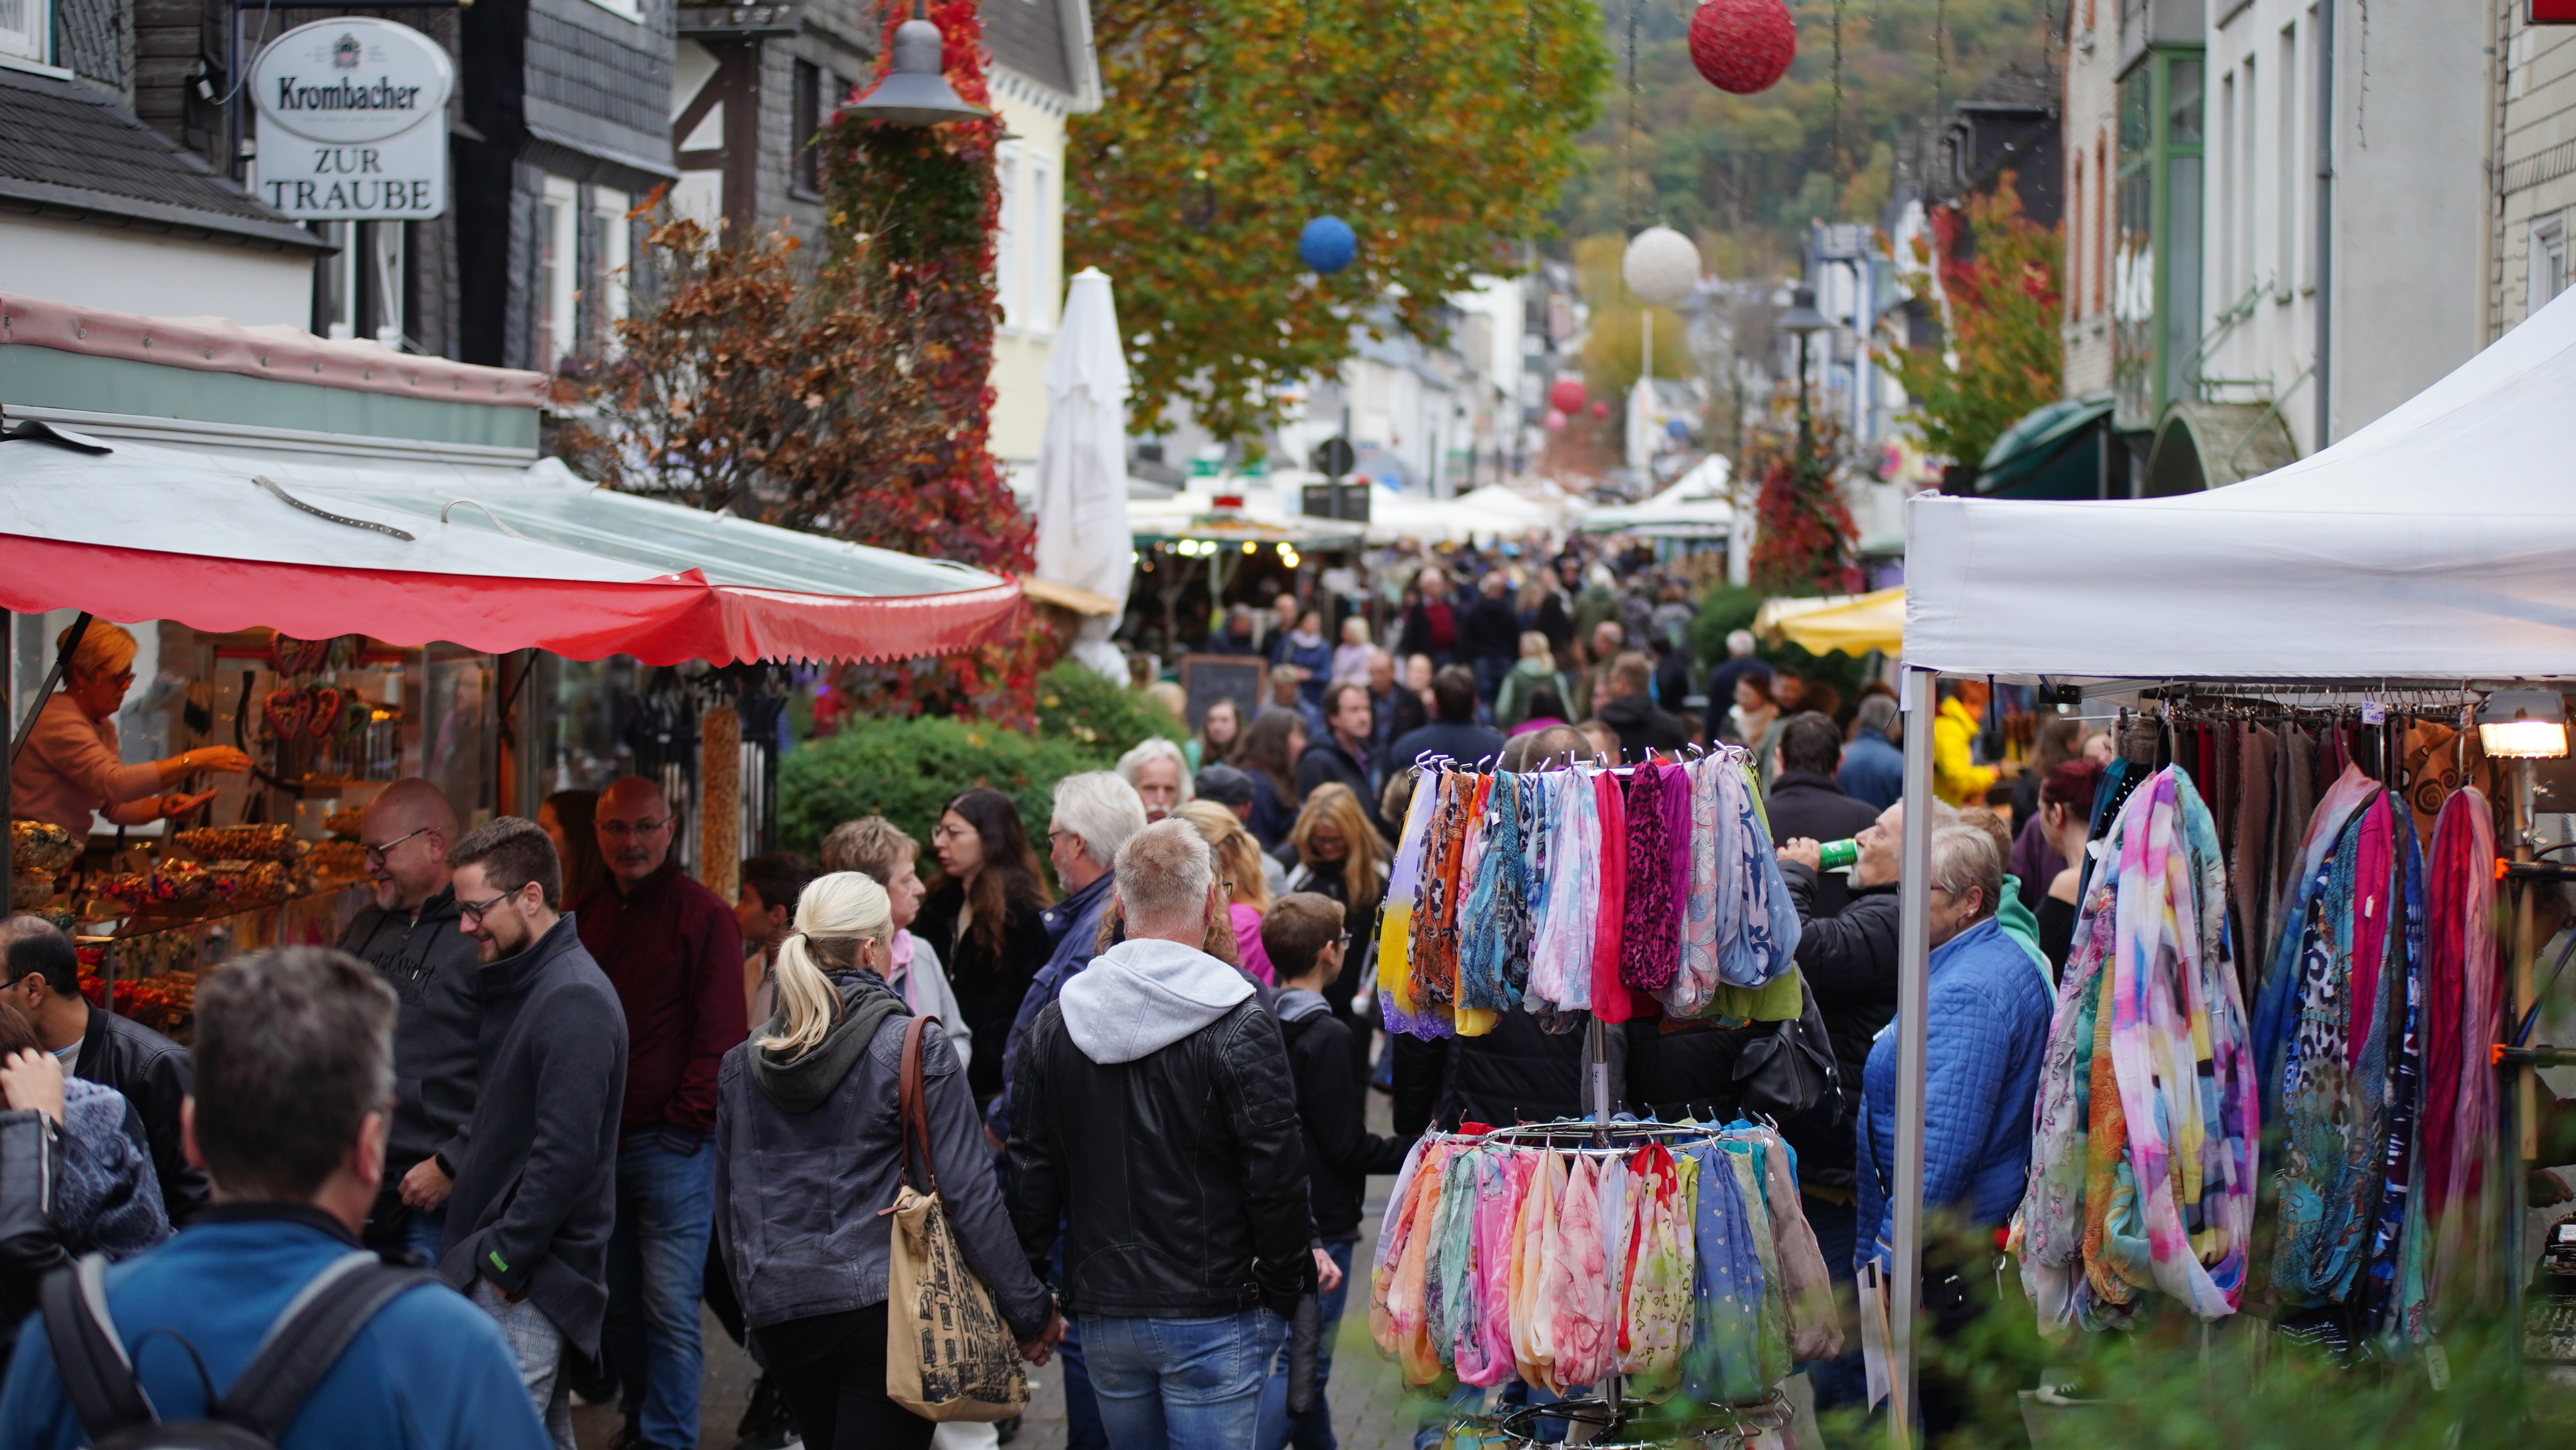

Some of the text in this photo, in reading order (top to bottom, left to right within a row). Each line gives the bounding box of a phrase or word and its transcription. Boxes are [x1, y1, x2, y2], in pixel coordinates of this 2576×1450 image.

[278, 75, 421, 111] Krombacher
[313, 148, 382, 174] ZUR
[266, 179, 433, 211] TRAUBE
